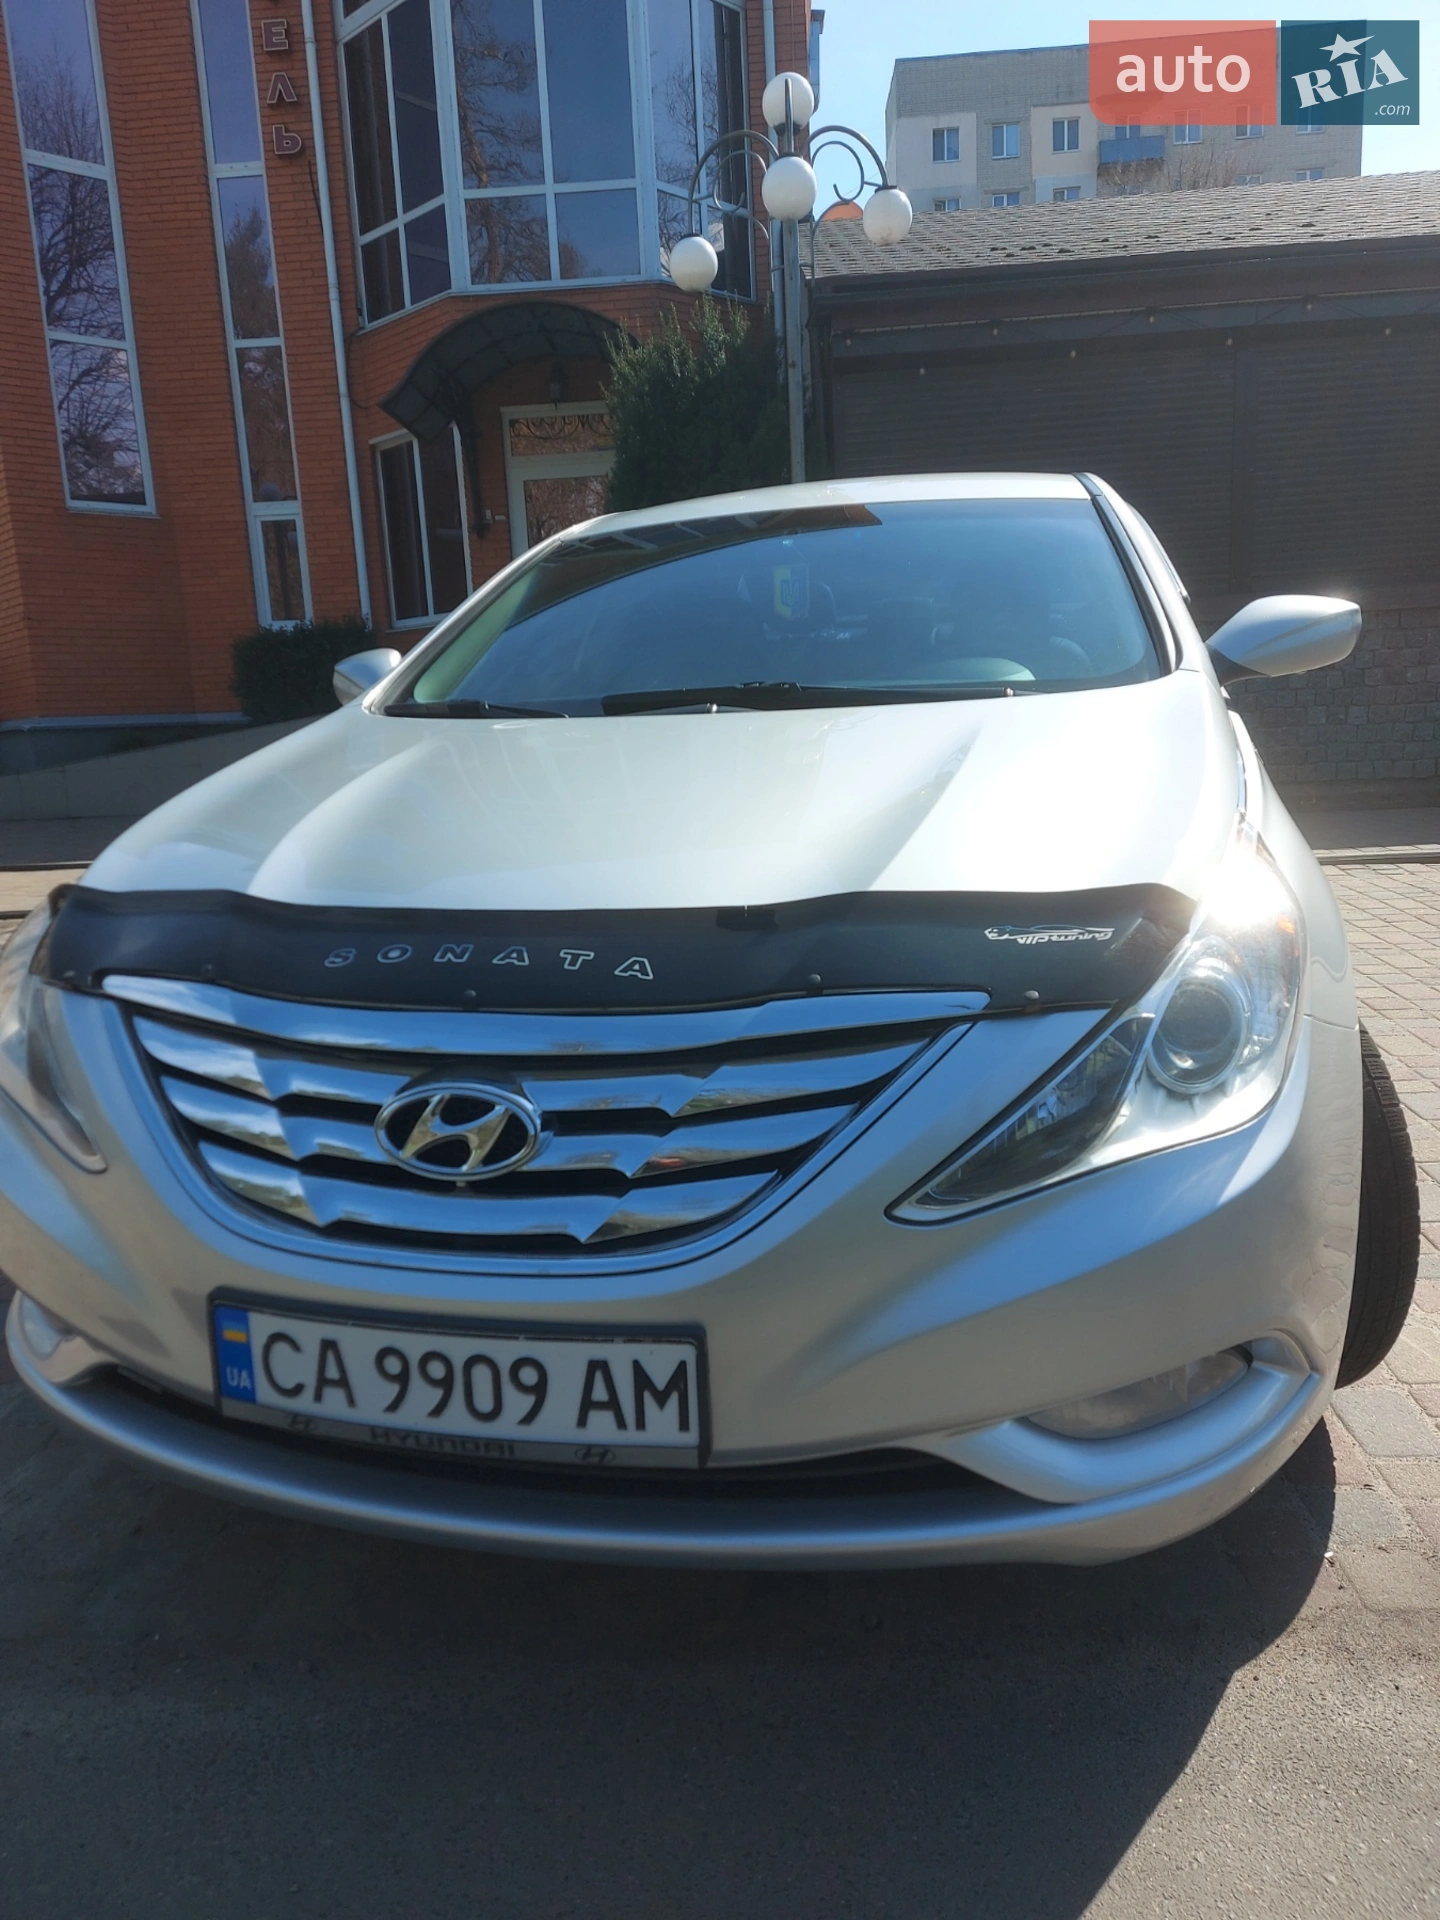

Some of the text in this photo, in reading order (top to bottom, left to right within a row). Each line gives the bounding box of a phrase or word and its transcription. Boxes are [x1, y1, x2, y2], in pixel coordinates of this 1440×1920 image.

[324, 944, 654, 980] SONATA
[225, 1367, 252, 1390] UA
[262, 1332, 691, 1433] CA 9909 AM
[369, 1428, 515, 1457] HYUNDAI
